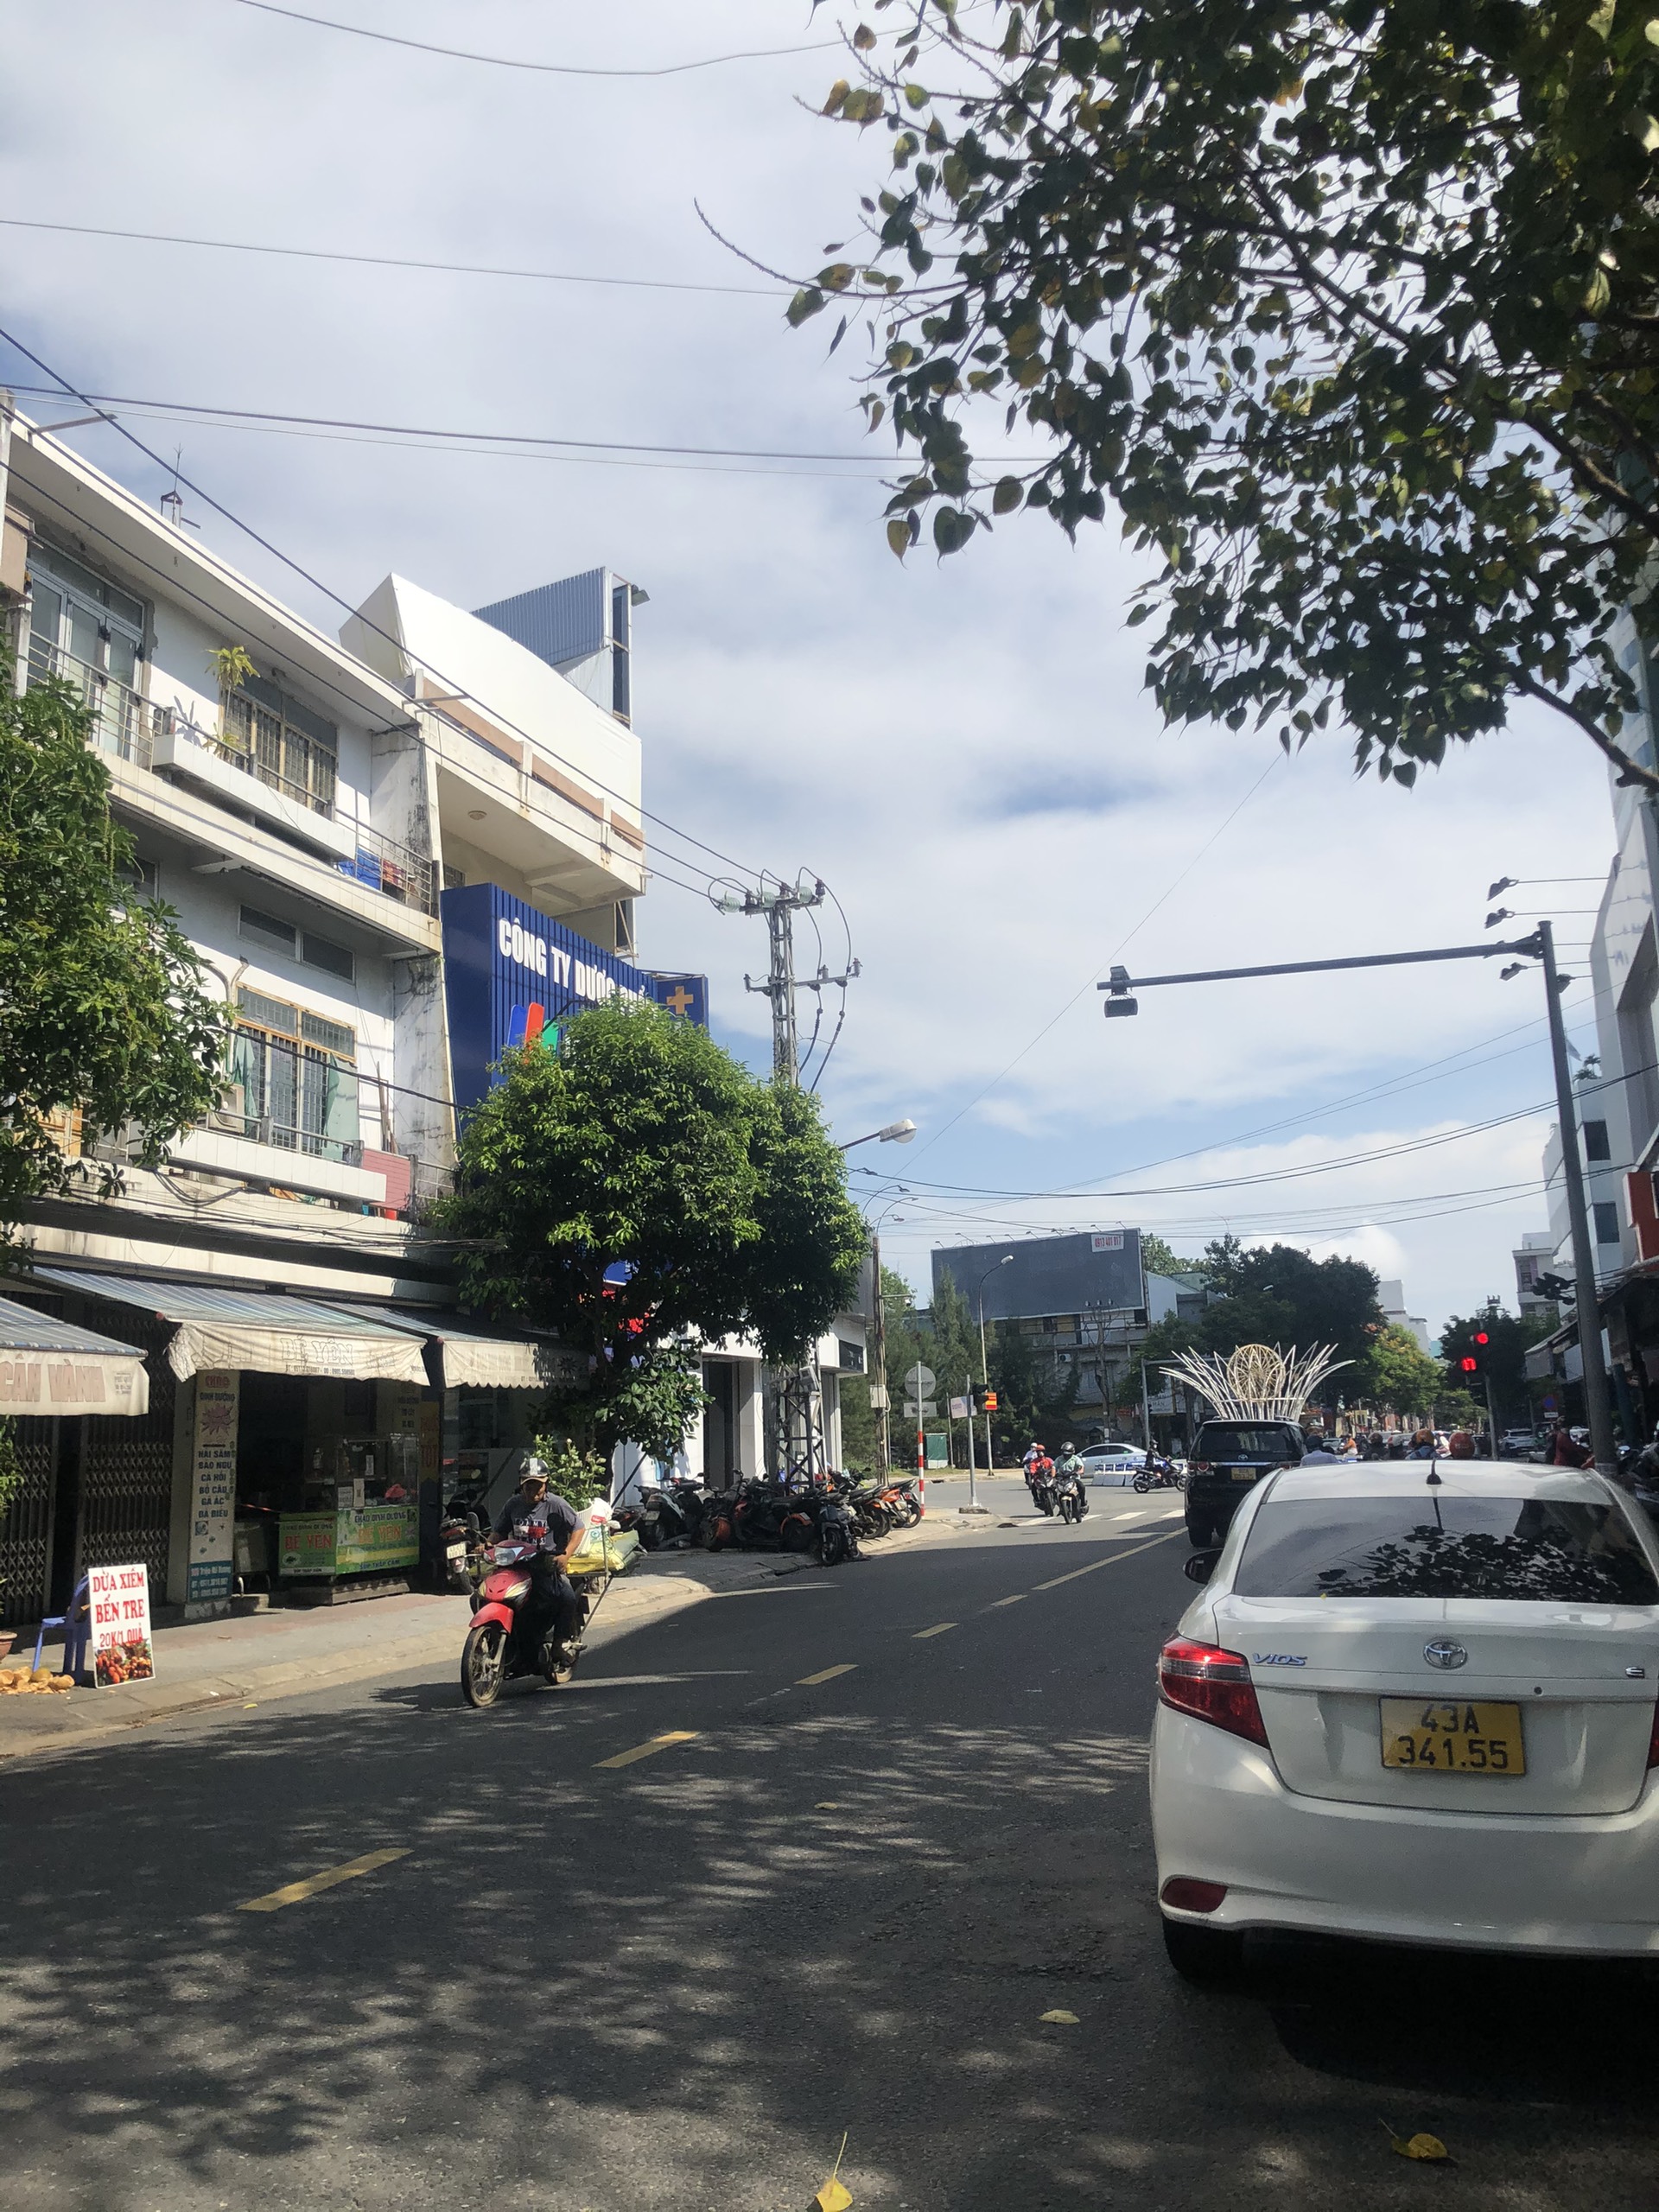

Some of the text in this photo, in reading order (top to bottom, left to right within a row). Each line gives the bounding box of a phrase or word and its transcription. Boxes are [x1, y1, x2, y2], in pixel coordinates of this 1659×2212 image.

[499, 917, 547, 977] CÔNG
[550, 945, 571, 988] TY
[311, 1337, 353, 1365] YÊN
[48, 1358, 106, 1402] VÀNH
[123, 1599, 144, 1619] TRE
[1252, 1652, 1308, 1666] VIOS
[1421, 1703, 1480, 1734] 43A
[1397, 1735, 1508, 1770] 341.55
